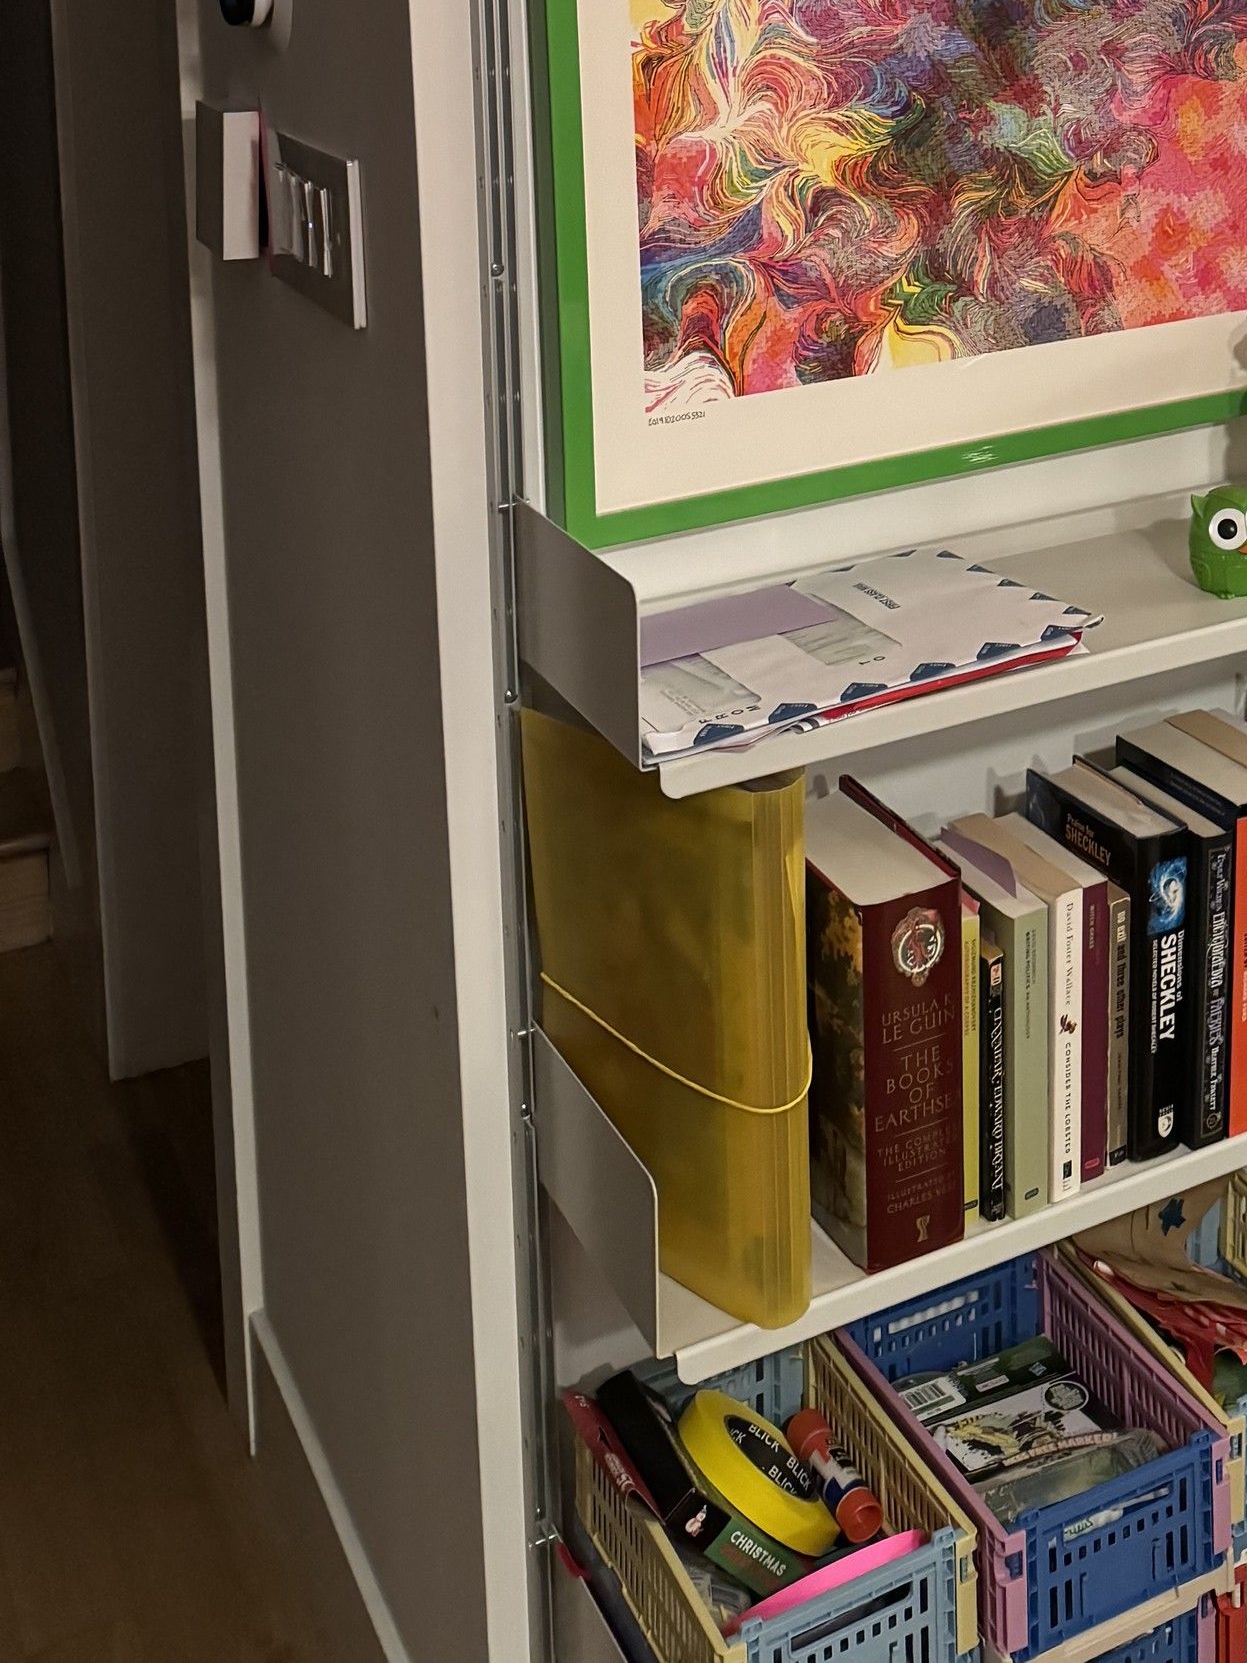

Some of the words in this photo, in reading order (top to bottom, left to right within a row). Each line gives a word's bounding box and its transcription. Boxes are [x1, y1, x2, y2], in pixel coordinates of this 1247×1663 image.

[698, 704, 761, 724] FROM
[1065, 824, 1112, 867] SHECKLEY
[1065, 902, 1074, 929] David
[1065, 933, 1074, 963] Foster
[1065, 967, 1074, 1006] Wallace
[1158, 932, 1178, 1040] SHECKLEY
[881, 998, 939, 1027] URSULA
[881, 1025, 903, 1045] LE
[909, 1005, 955, 1036] GUIN
[900, 1044, 941, 1071] THE
[1064, 1042, 1072, 1085] CONSIDER
[908, 1082, 935, 1104] OF
[1064, 1093, 1072, 1111] THE
[748, 1422, 780, 1453] BLICK
[767, 1465, 799, 1496] BLIC
[786, 1456, 812, 1491] BLICK
[729, 1530, 787, 1578] CHRISTMAS
